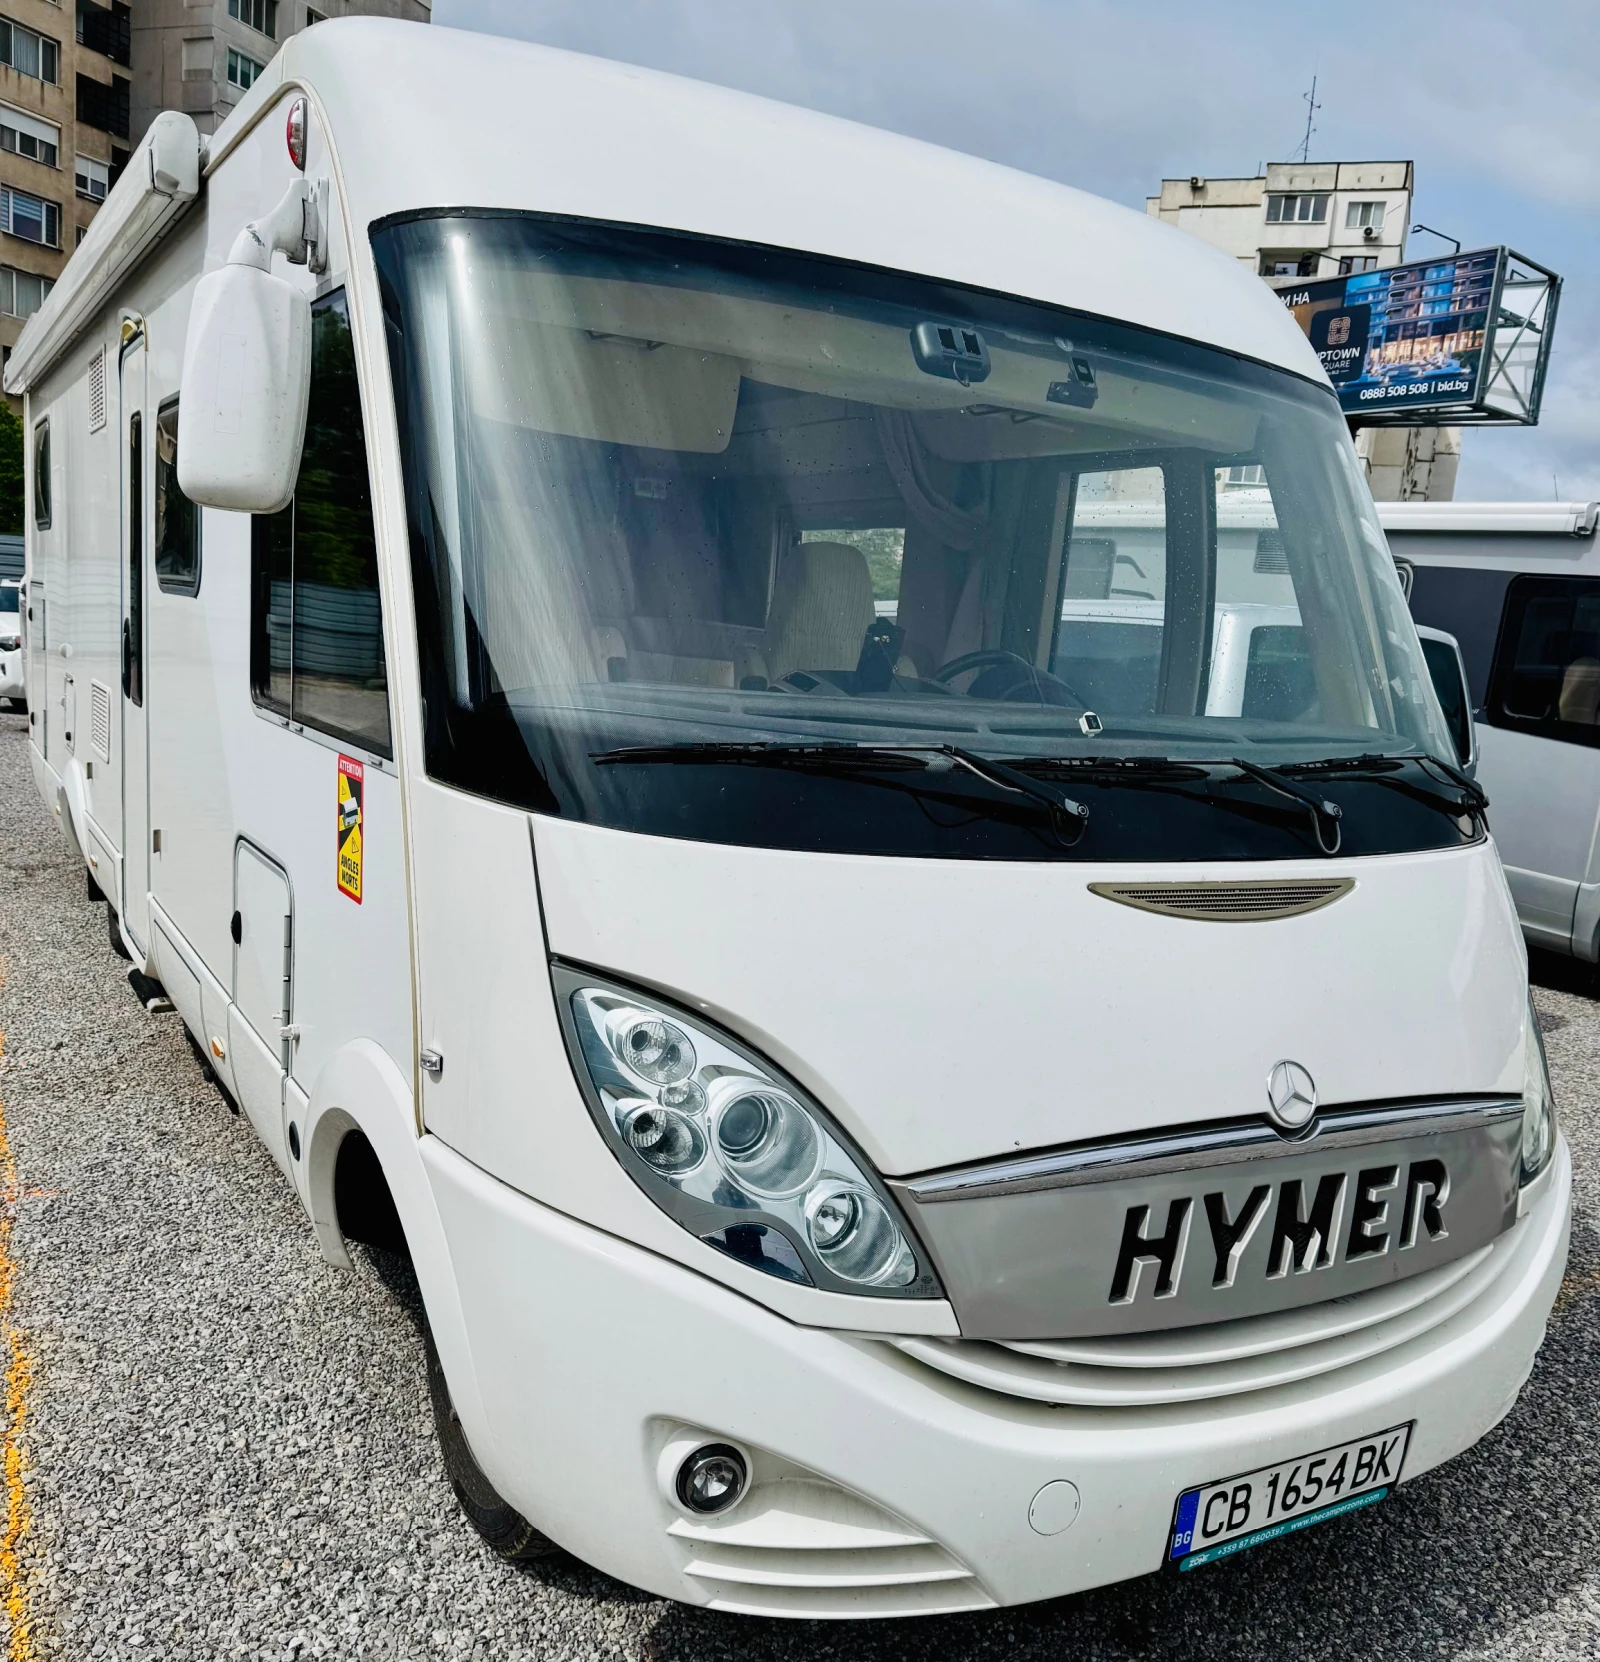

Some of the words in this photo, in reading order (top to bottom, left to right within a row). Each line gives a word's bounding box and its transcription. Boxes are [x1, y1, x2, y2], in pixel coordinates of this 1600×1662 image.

[1324, 359, 1351, 370] QUARE
[1360, 388, 1386, 400] 0888
[1386, 385, 1407, 397] 508
[1408, 382, 1429, 394] 508
[1437, 379, 1469, 393] bld.bg
[339, 759, 363, 778] ATTENTION
[340, 853, 359, 876] ANGLES
[341, 869, 358, 891] MORTS
[1108, 1158, 1451, 1306] HYMER
[1201, 1483, 1253, 1538] CB
[1266, 1452, 1349, 1519] 1654
[1350, 1435, 1400, 1490] BK
[1173, 1530, 1191, 1548] BG
[1217, 1543, 1237, 1556] +359
[1238, 1539, 1249, 1552] 87
